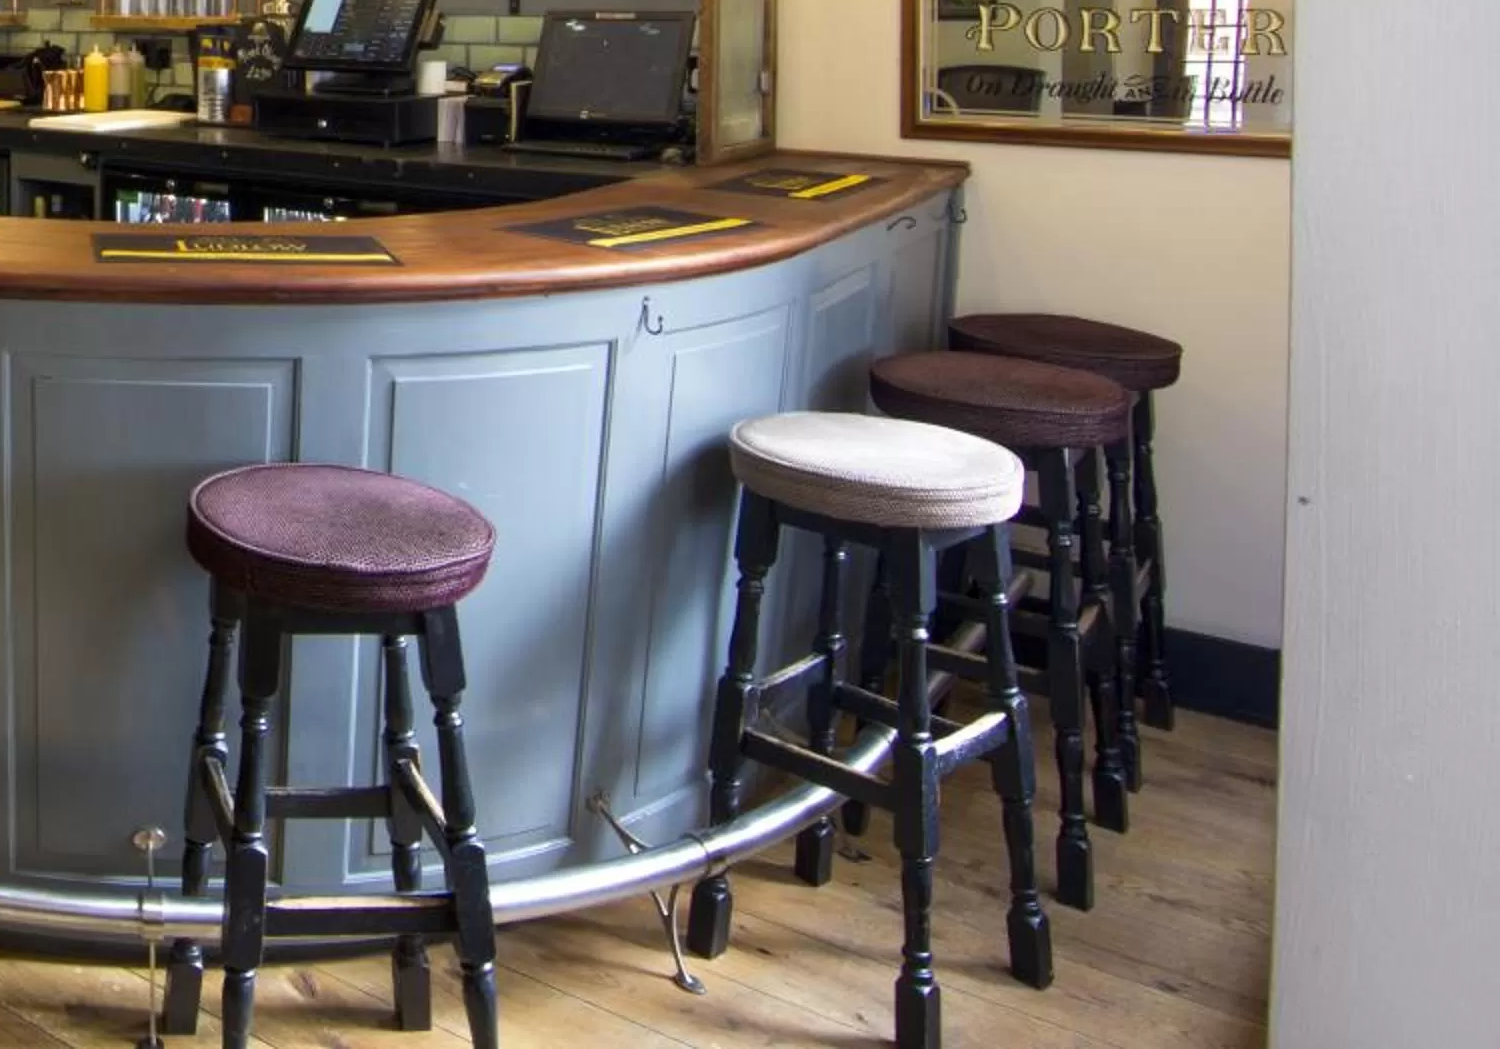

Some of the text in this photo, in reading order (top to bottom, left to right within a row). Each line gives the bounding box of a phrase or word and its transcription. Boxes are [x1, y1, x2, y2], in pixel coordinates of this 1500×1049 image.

[966, 2, 1287, 56] PORTER
[965, 72, 1002, 97] On
[1011, 70, 1119, 102] Draught
